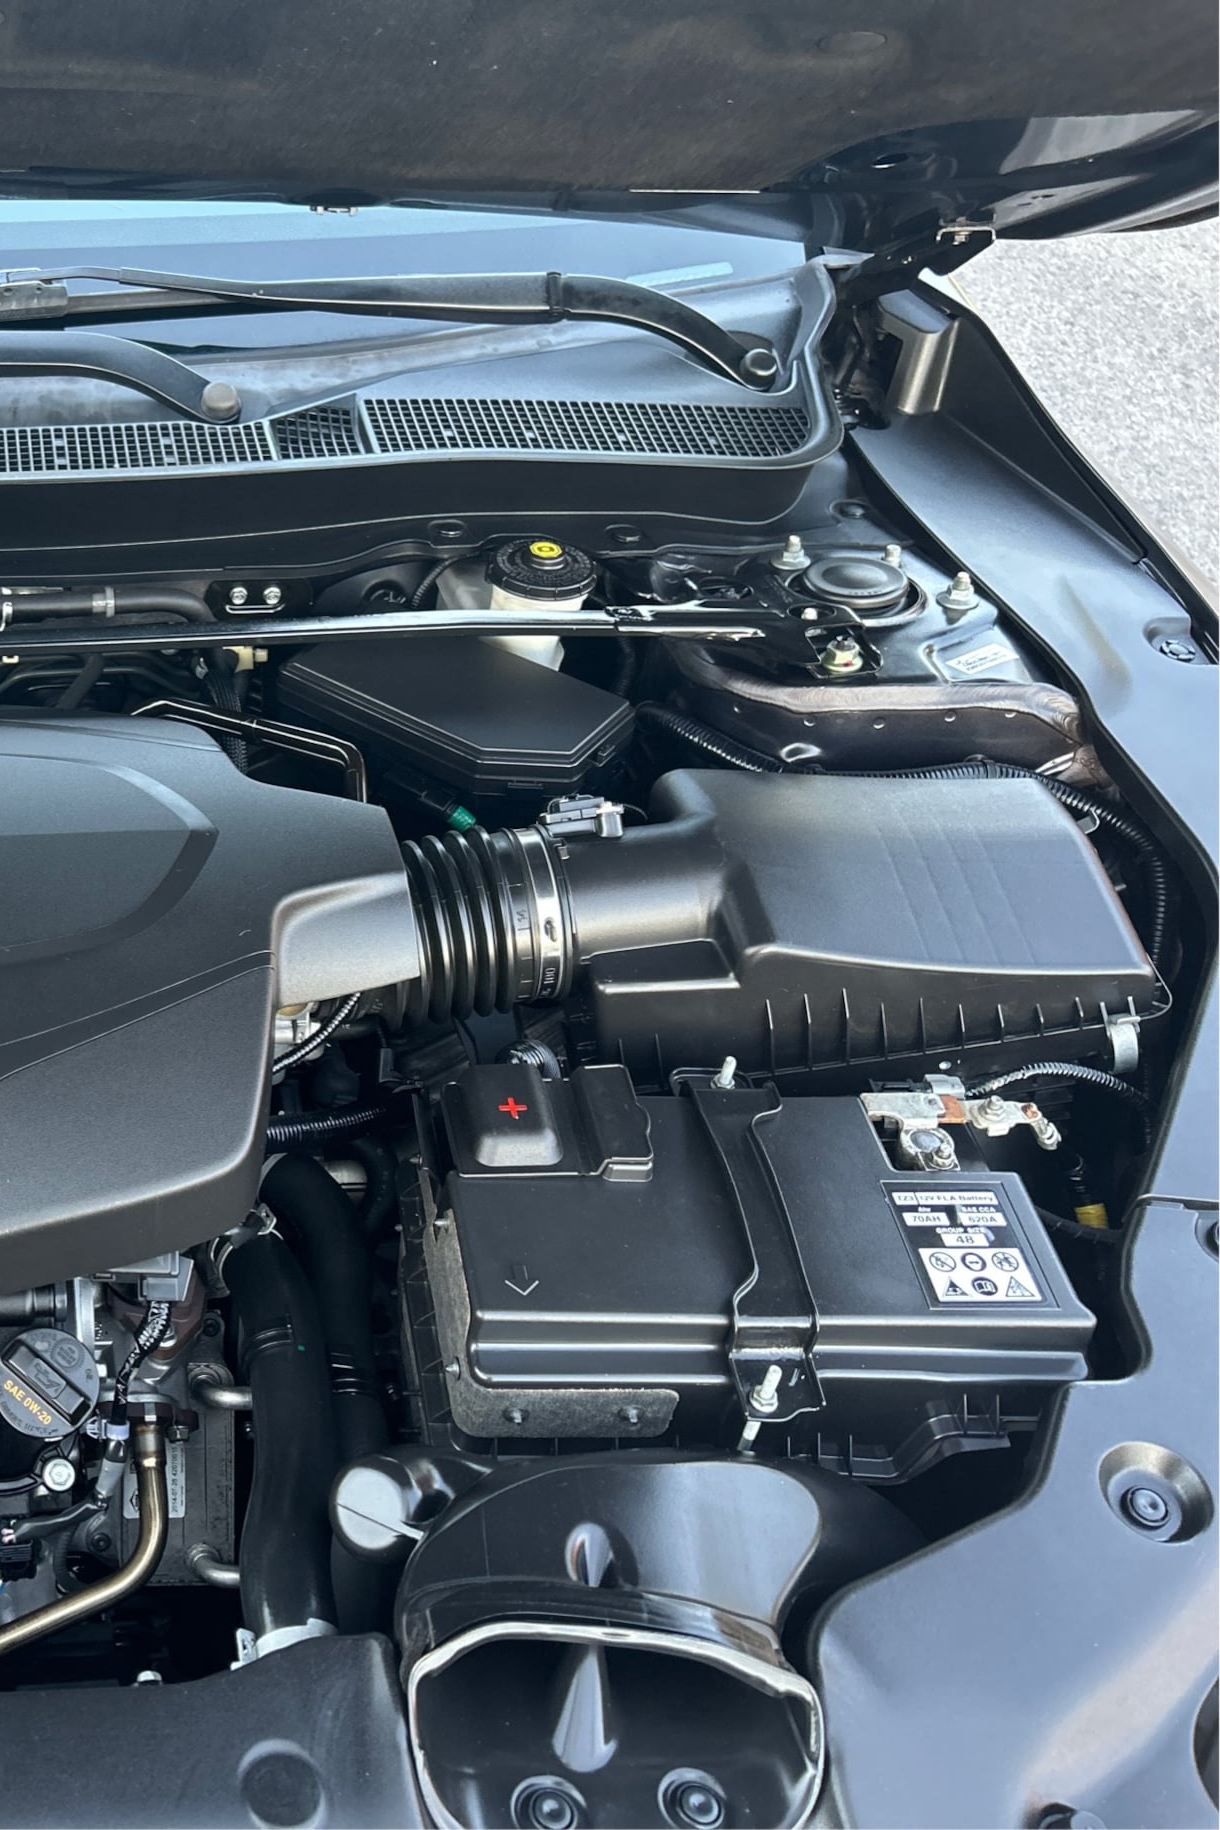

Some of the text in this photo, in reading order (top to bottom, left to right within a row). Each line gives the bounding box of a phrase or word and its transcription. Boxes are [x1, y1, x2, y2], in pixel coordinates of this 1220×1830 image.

[919, 1194, 935, 1202] 12V
[936, 1194, 957, 1202] FLA
[958, 1194, 993, 1202] Battery
[912, 1214, 941, 1223] 70AH
[968, 1214, 998, 1223] 620A
[955, 1235, 975, 1245] 48
[3, 1379, 26, 1401] SAE
[23, 1397, 53, 1425] 0W-20
